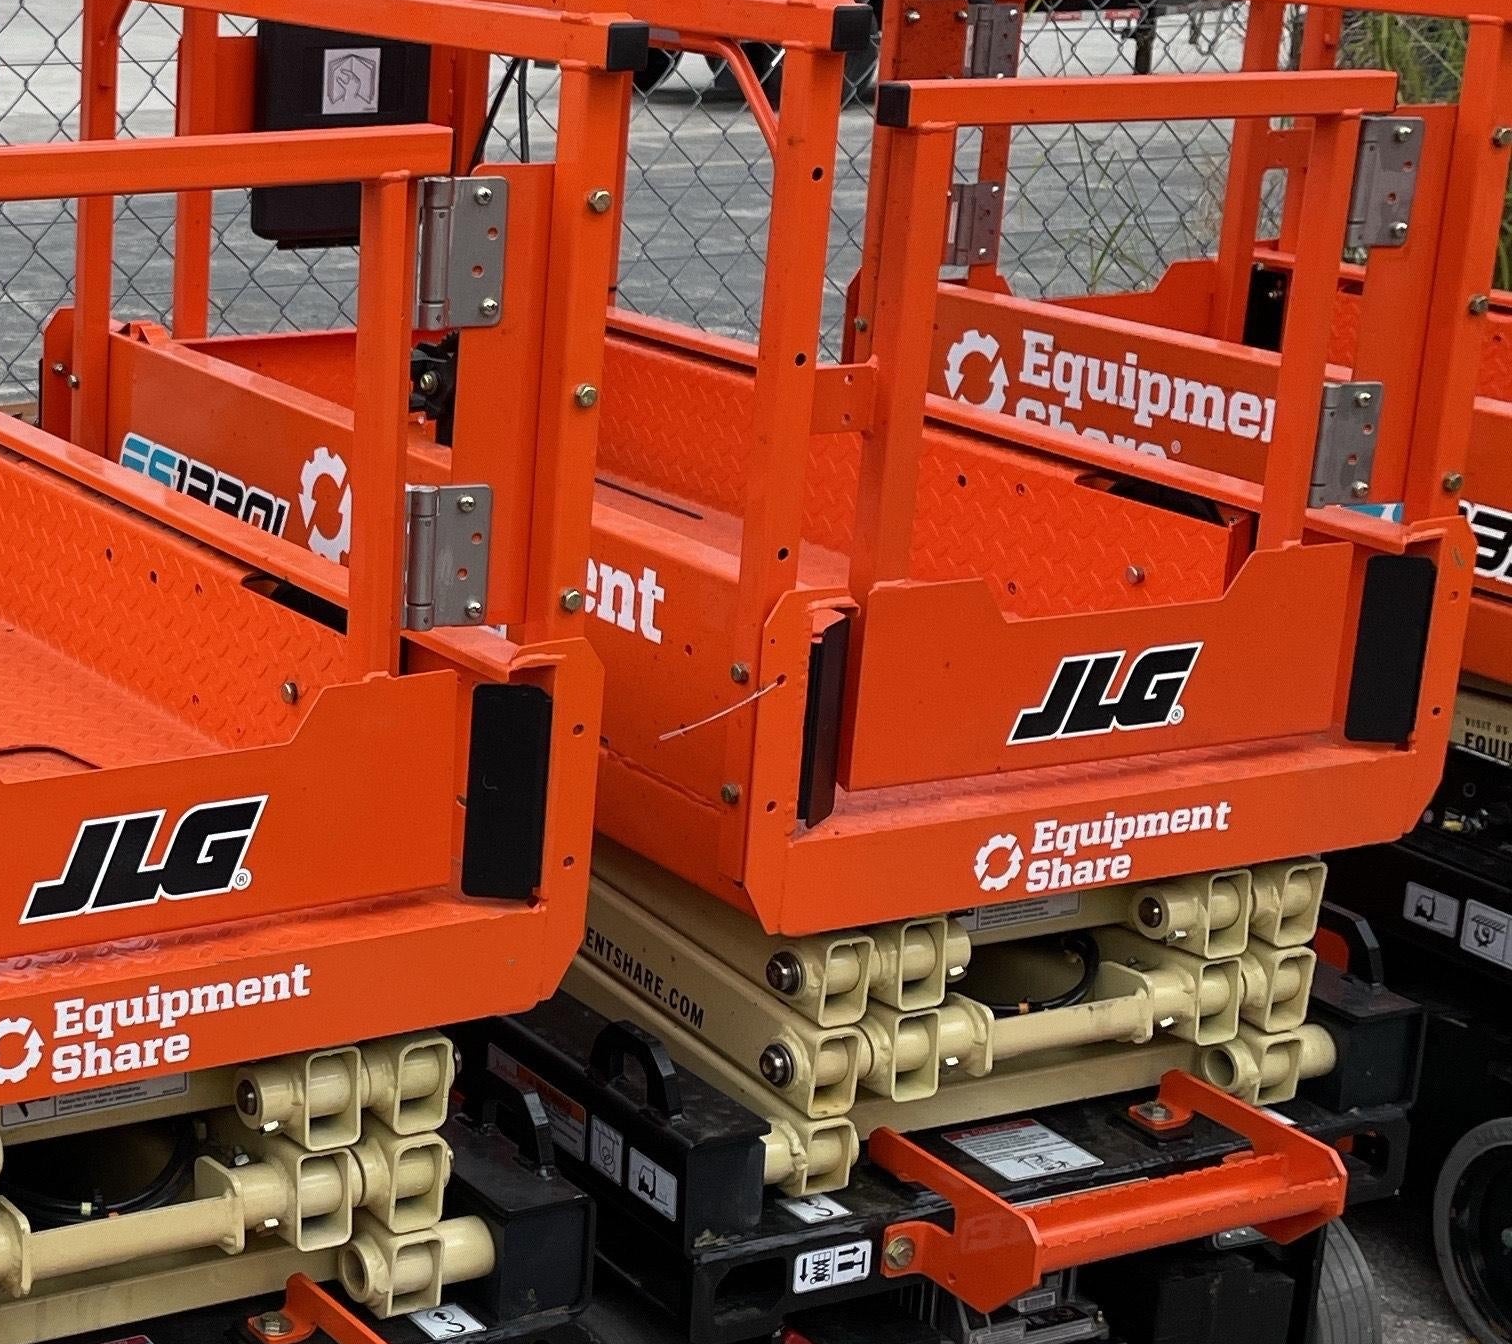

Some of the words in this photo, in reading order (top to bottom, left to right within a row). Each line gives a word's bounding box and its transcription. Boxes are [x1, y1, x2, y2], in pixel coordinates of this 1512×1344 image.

[1006, 640, 1204, 747] JLG
[18, 794, 270, 926] JLG
[1030, 800, 1232, 854] Equipment
[1025, 853, 1132, 895] Share
[53, 962, 311, 1039] Equipment
[586, 926, 704, 1030] ENTSHARE.COM
[51, 1032, 190, 1085] Share
